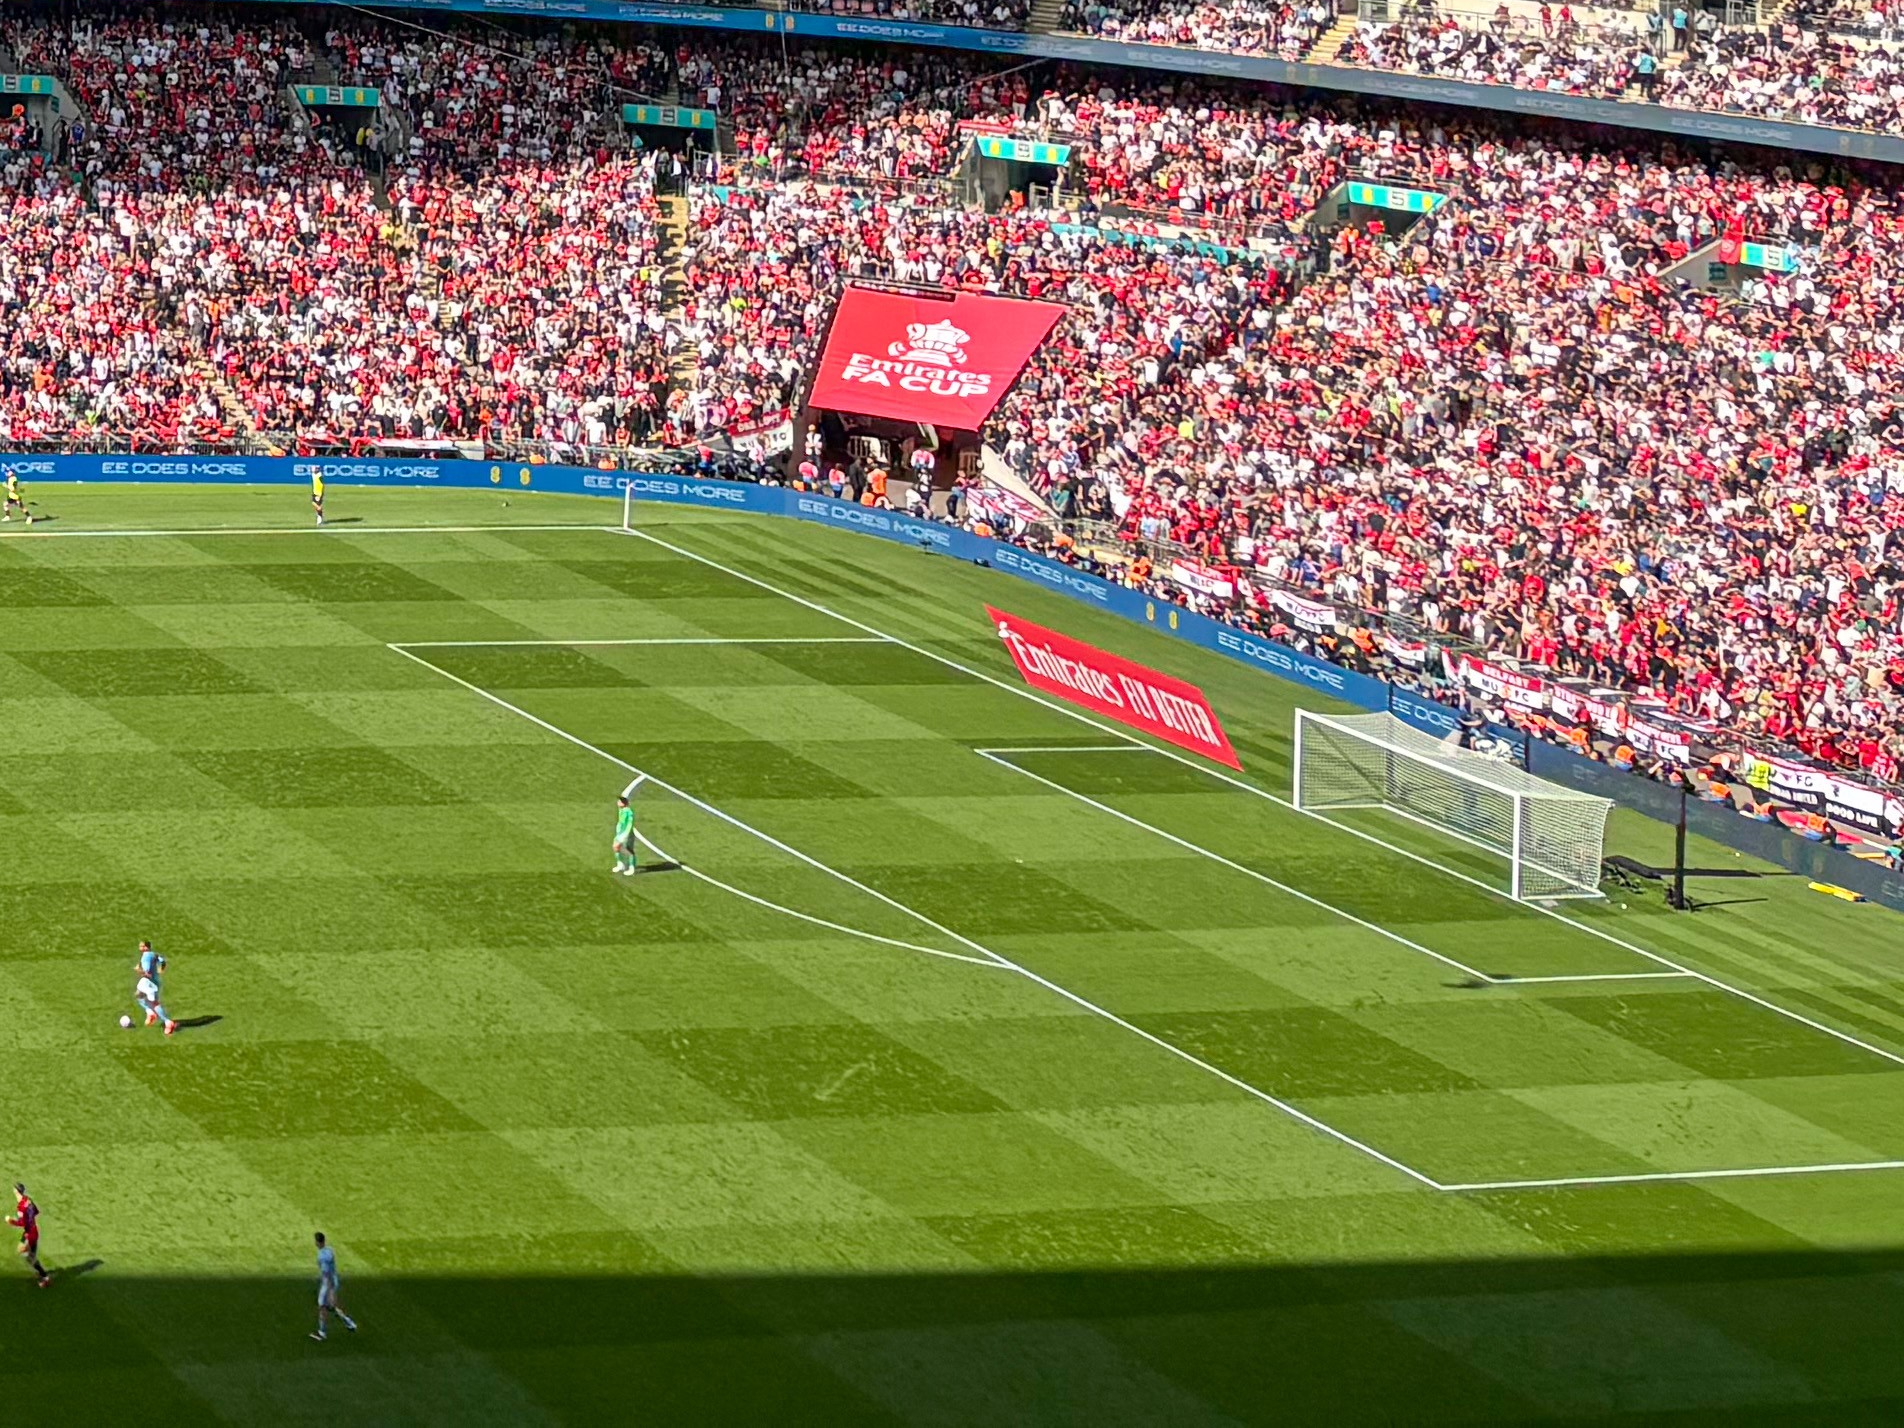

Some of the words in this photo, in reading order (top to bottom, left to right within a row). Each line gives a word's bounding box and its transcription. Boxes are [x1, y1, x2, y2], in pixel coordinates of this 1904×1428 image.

[841, 365, 891, 387] FA
[899, 376, 989, 397] CUP
[849, 353, 991, 385] Emirates
[1, 461, 55, 473] MORE
[102, 462, 129, 474] EE
[132, 462, 188, 474] DOES
[192, 463, 247, 475] MORE
[323, 464, 380, 477] DOES
[383, 466, 439, 478] MORE
[583, 475, 613, 488] EE
[616, 478, 679, 493] DOES
[683, 484, 745, 502] MORE
[799, 499, 828, 516] EE
[831, 505, 891, 530] DOES
[893, 520, 950, 547] MORE
[995, 548, 1018, 565] EE
[1020, 555, 1063, 583] DOES
[1064, 575, 1107, 601] MORE
[1218, 631, 1241, 652] EE
[1242, 637, 1292, 670] DOES
[1294, 660, 1344, 690] MORE
[1007, 630, 1124, 708] Emirates
[1148, 685, 1222, 747] BETTER
[1482, 664, 1530, 688] BELFAST
[1414, 705, 1462, 732] DOE
